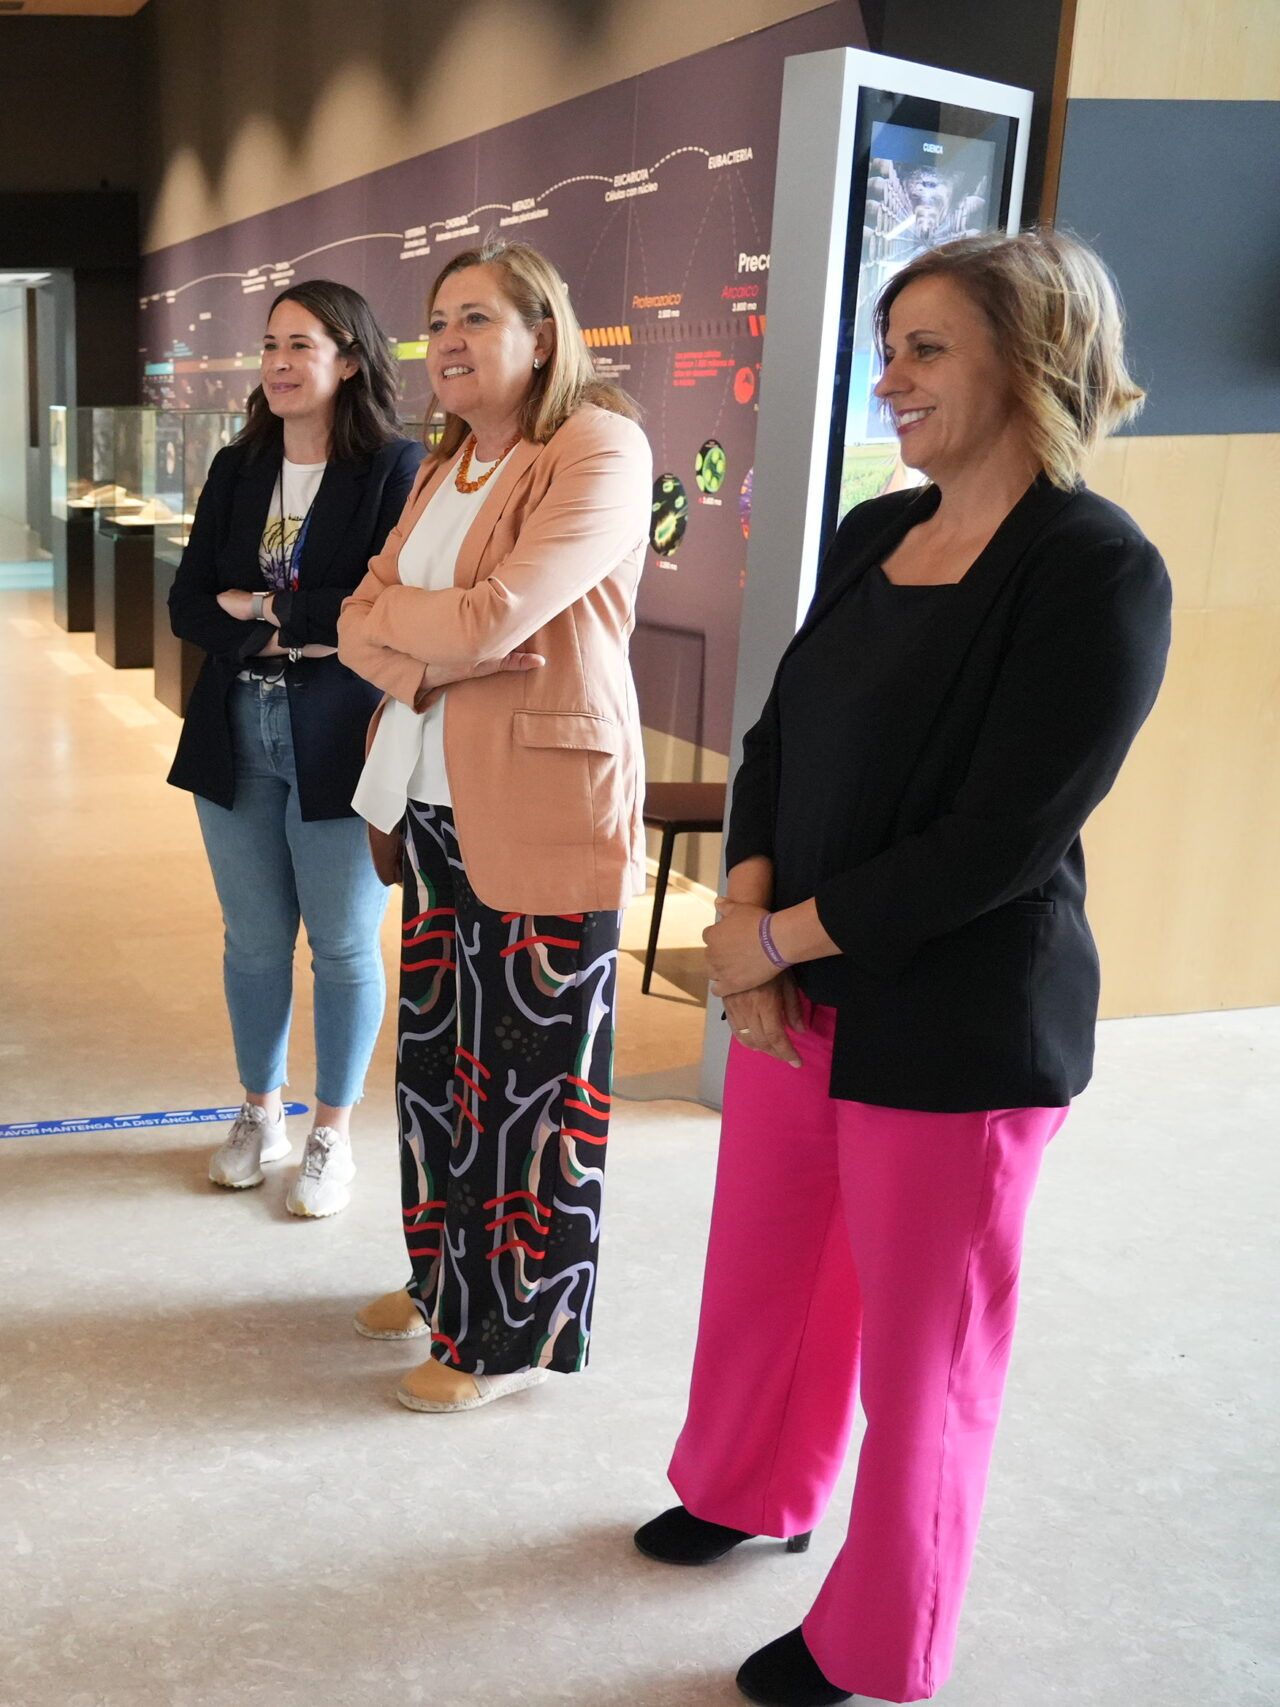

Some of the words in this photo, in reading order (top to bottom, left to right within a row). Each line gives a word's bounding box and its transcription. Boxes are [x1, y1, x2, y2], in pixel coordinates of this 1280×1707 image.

[923, 142, 943, 155] CUENCA
[708, 147, 753, 170] EUBACTERIA
[40, 1122, 113, 1134] MANTENGA
[114, 1120, 132, 1128] LA
[132, 1115, 200, 1127] DISTANCIA
